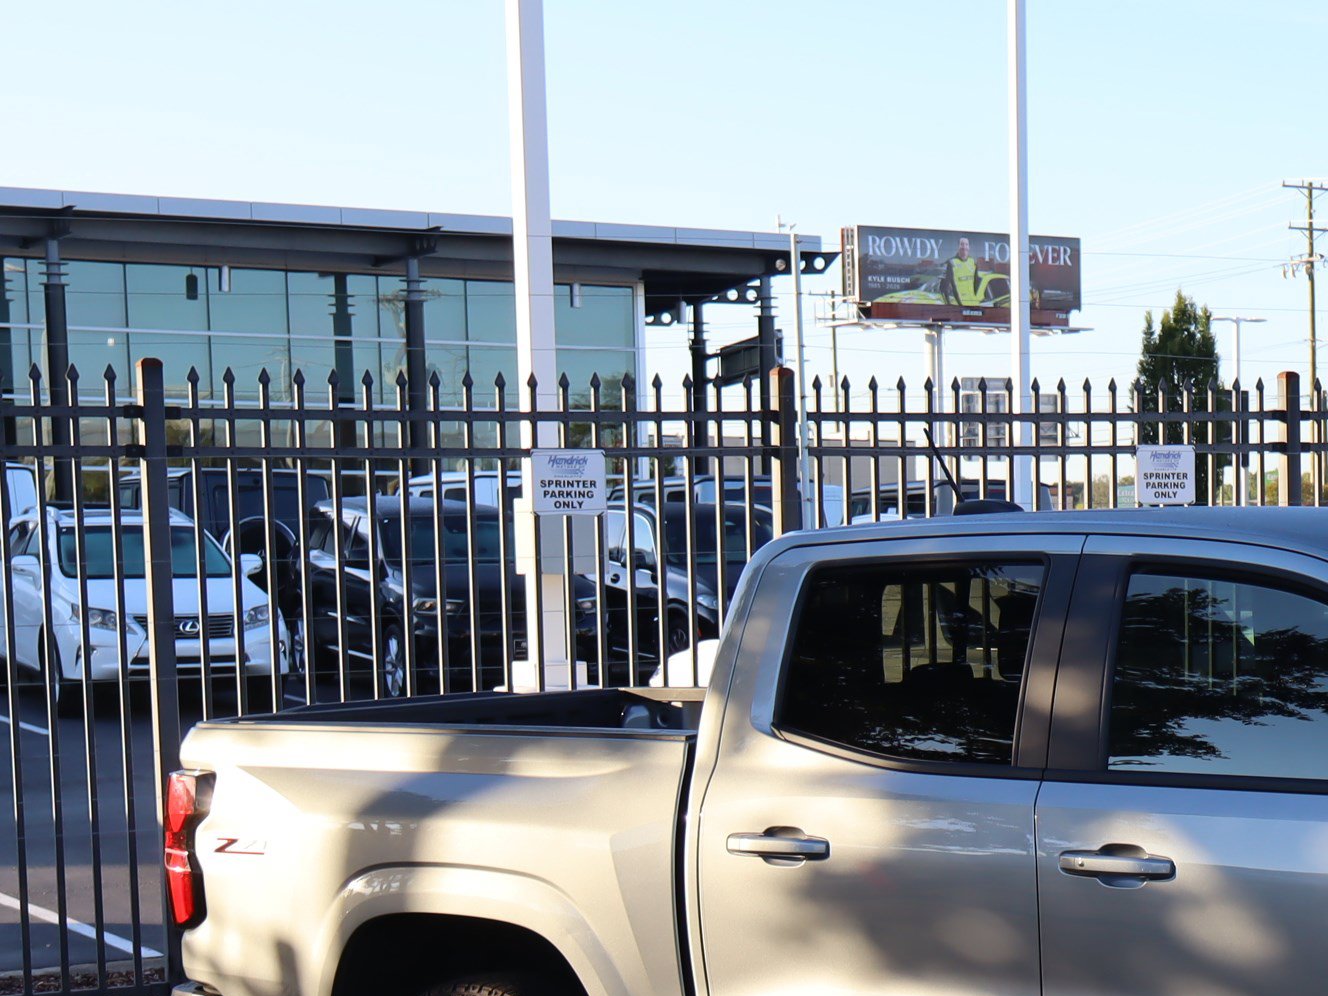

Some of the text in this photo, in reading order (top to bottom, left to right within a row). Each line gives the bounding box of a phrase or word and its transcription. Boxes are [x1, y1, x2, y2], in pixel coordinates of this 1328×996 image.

[868, 235, 1073, 266] ROWDY FOEVER
[886, 276, 910, 284] BUSCH
[1150, 451, 1182, 462] Hendrick
[548, 455, 588, 468] Hendrick
[540, 480, 597, 488] SPRINTER
[543, 490, 594, 499] PARKING
[554, 500, 584, 509] ONLY
